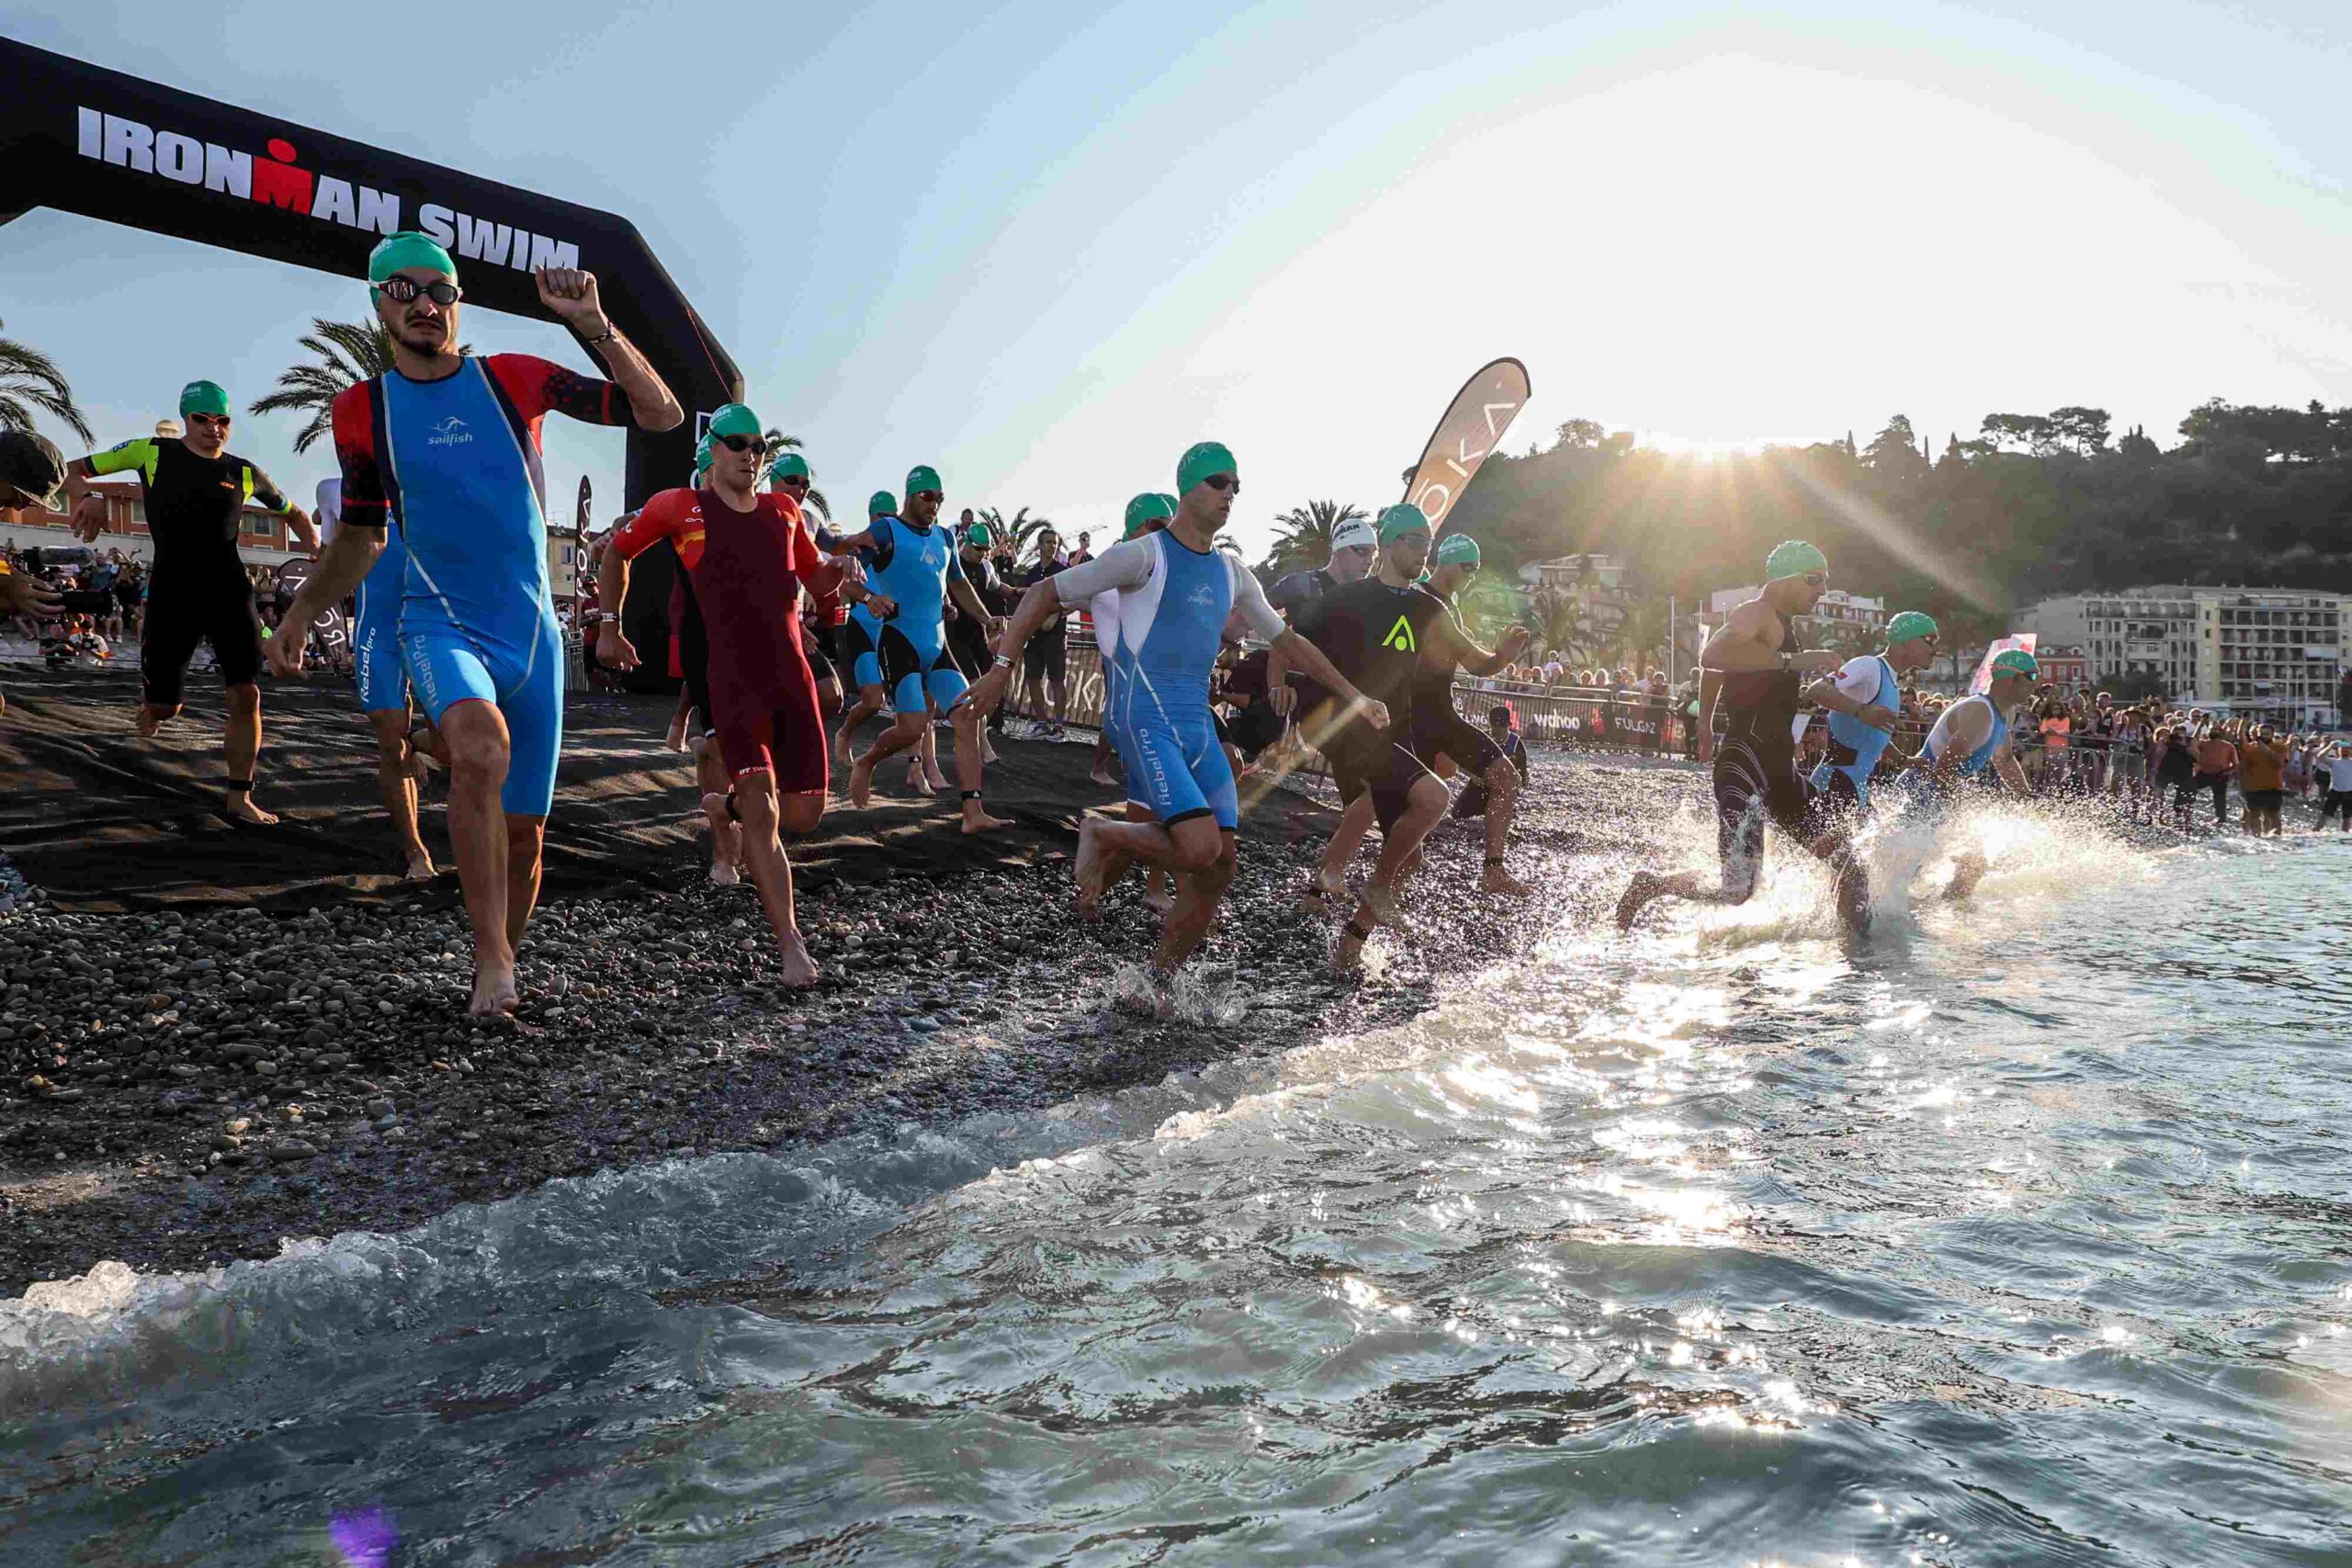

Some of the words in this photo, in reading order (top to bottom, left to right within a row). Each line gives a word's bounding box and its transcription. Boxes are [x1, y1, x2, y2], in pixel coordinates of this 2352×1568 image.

[78, 106, 400, 236] IRONMAN
[419, 203, 580, 275] SWIM
[426, 432, 473, 447] sailfish
[1533, 708, 1581, 729] wahoo
[1614, 716, 1657, 734] FULGAZ
